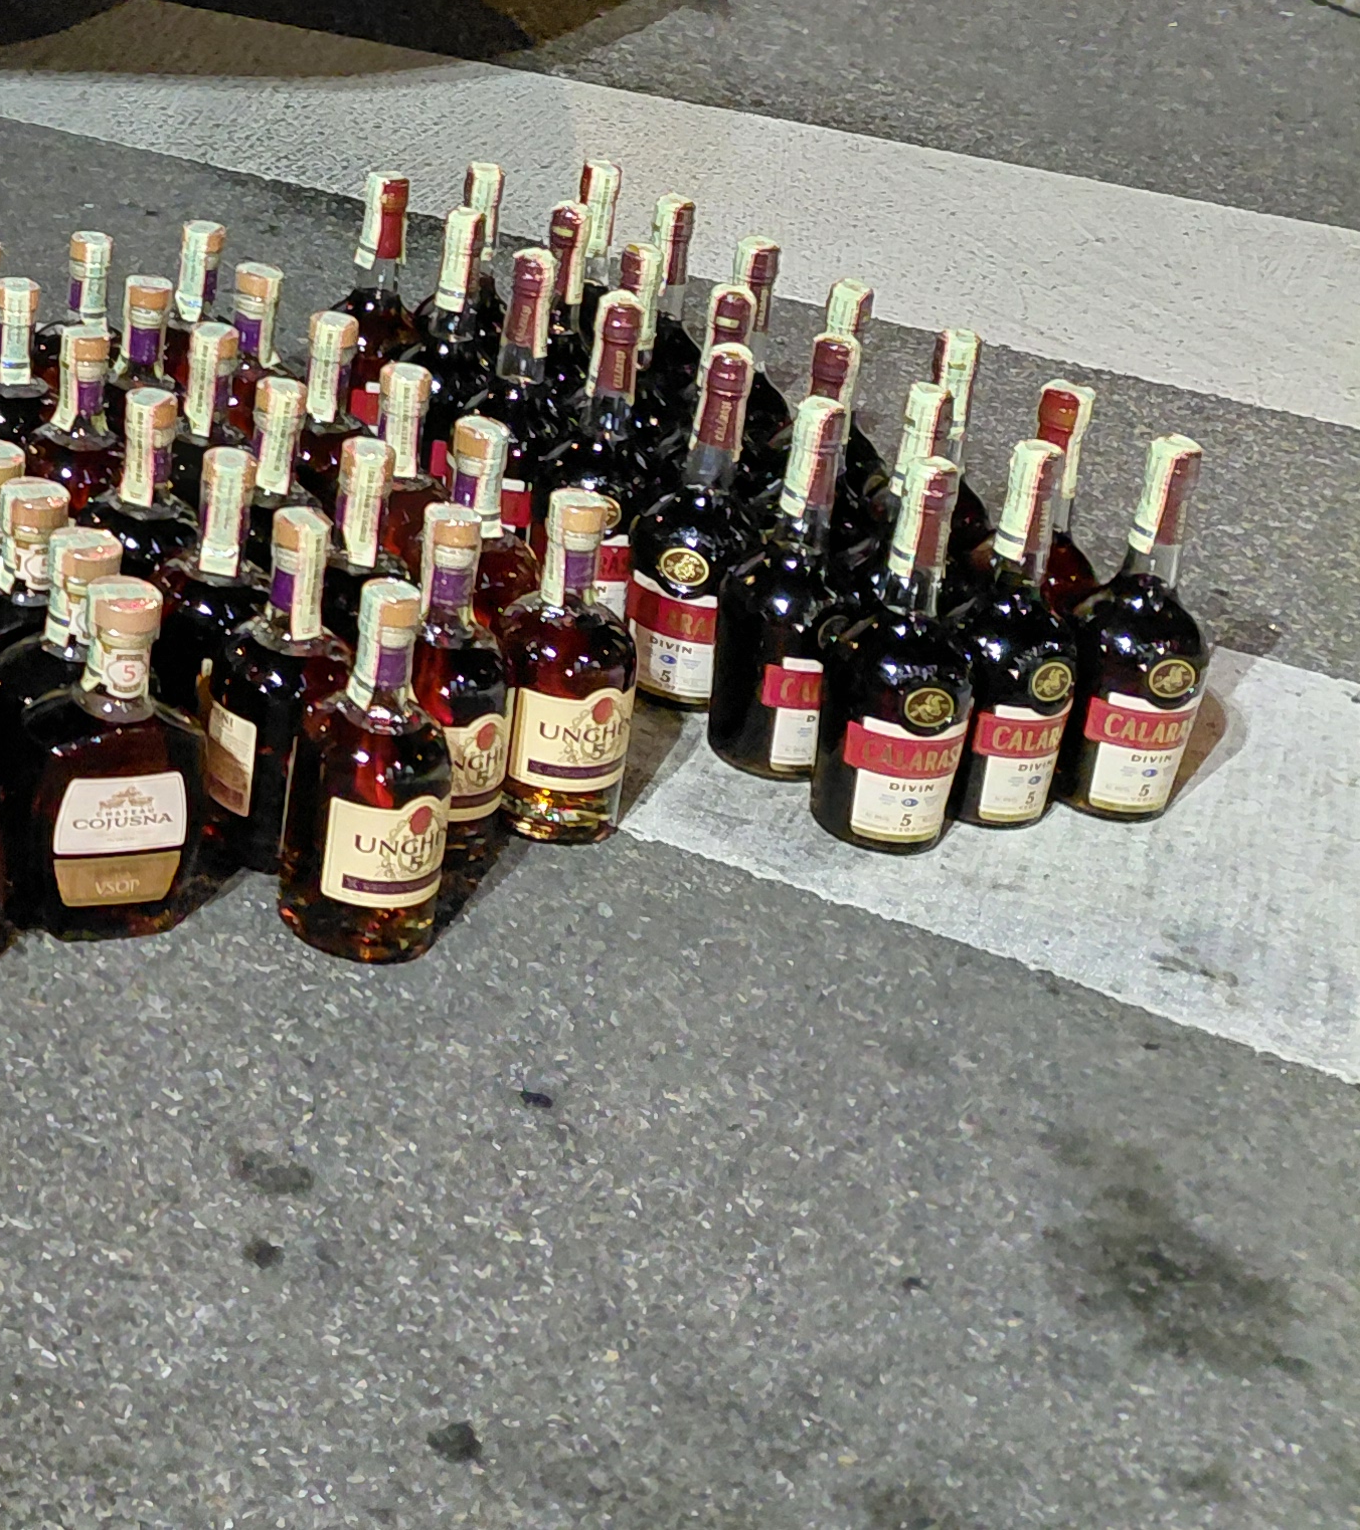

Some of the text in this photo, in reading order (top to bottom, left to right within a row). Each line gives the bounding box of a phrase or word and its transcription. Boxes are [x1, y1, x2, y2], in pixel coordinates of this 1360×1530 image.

[649, 634, 694, 656] DIVIN
[122, 663, 137, 682] 5
[659, 669, 672, 683] 5
[592, 744, 606, 760] 5
[1130, 753, 1172, 765] DIVIN
[1017, 758, 1054, 773] DIVIN
[888, 781, 935, 794] DIVIN
[1138, 783, 1151, 798] 5
[1025, 789, 1037, 805] 5
[899, 813, 913, 827] 5
[410, 855, 424, 871] 5
[94, 878, 141, 896] VSOP
